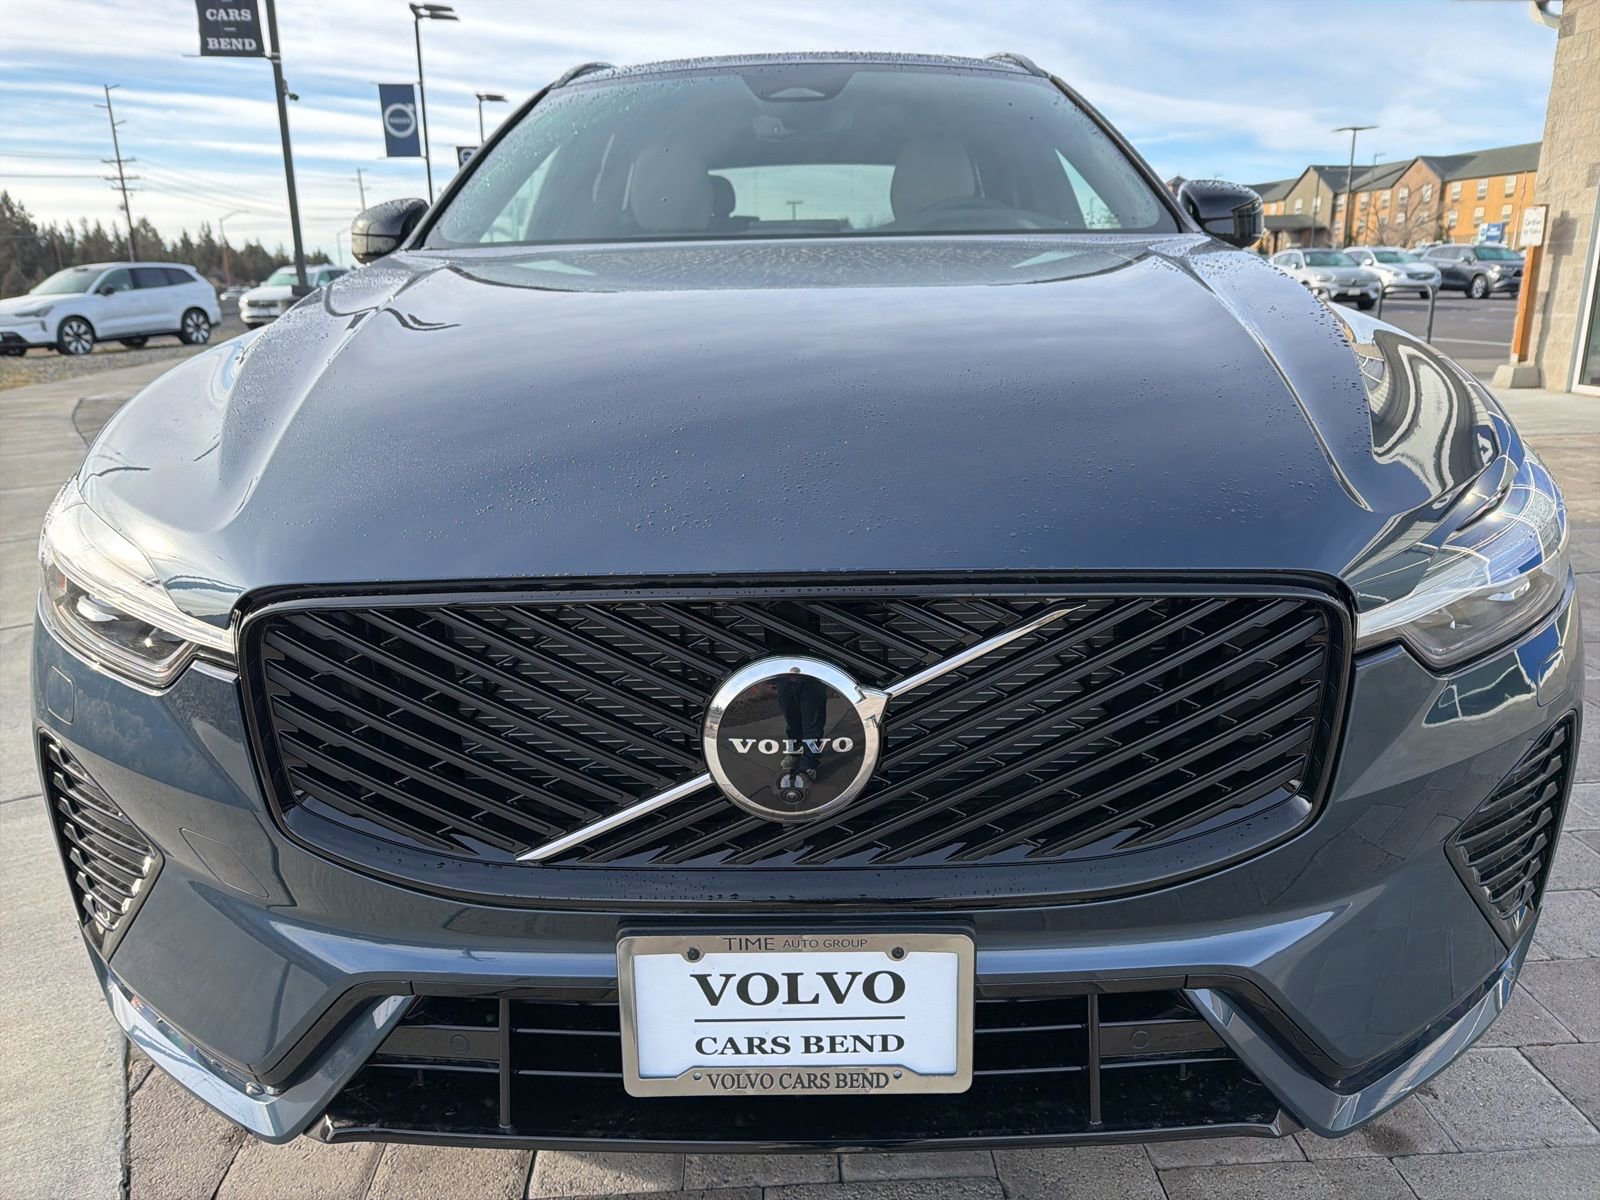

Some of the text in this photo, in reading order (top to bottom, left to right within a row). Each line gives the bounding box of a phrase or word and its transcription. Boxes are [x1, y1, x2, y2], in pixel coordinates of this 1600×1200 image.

[205, 8, 252, 21] CARS
[207, 37, 257, 50] BEND
[729, 737, 854, 754] VOLVO
[723, 937, 868, 951] TIME AUTO GROUP
[690, 970, 906, 1006] VOLVO
[695, 1033, 905, 1055] CARS BEND
[706, 1072, 889, 1090] VOLVO CARS BEND
